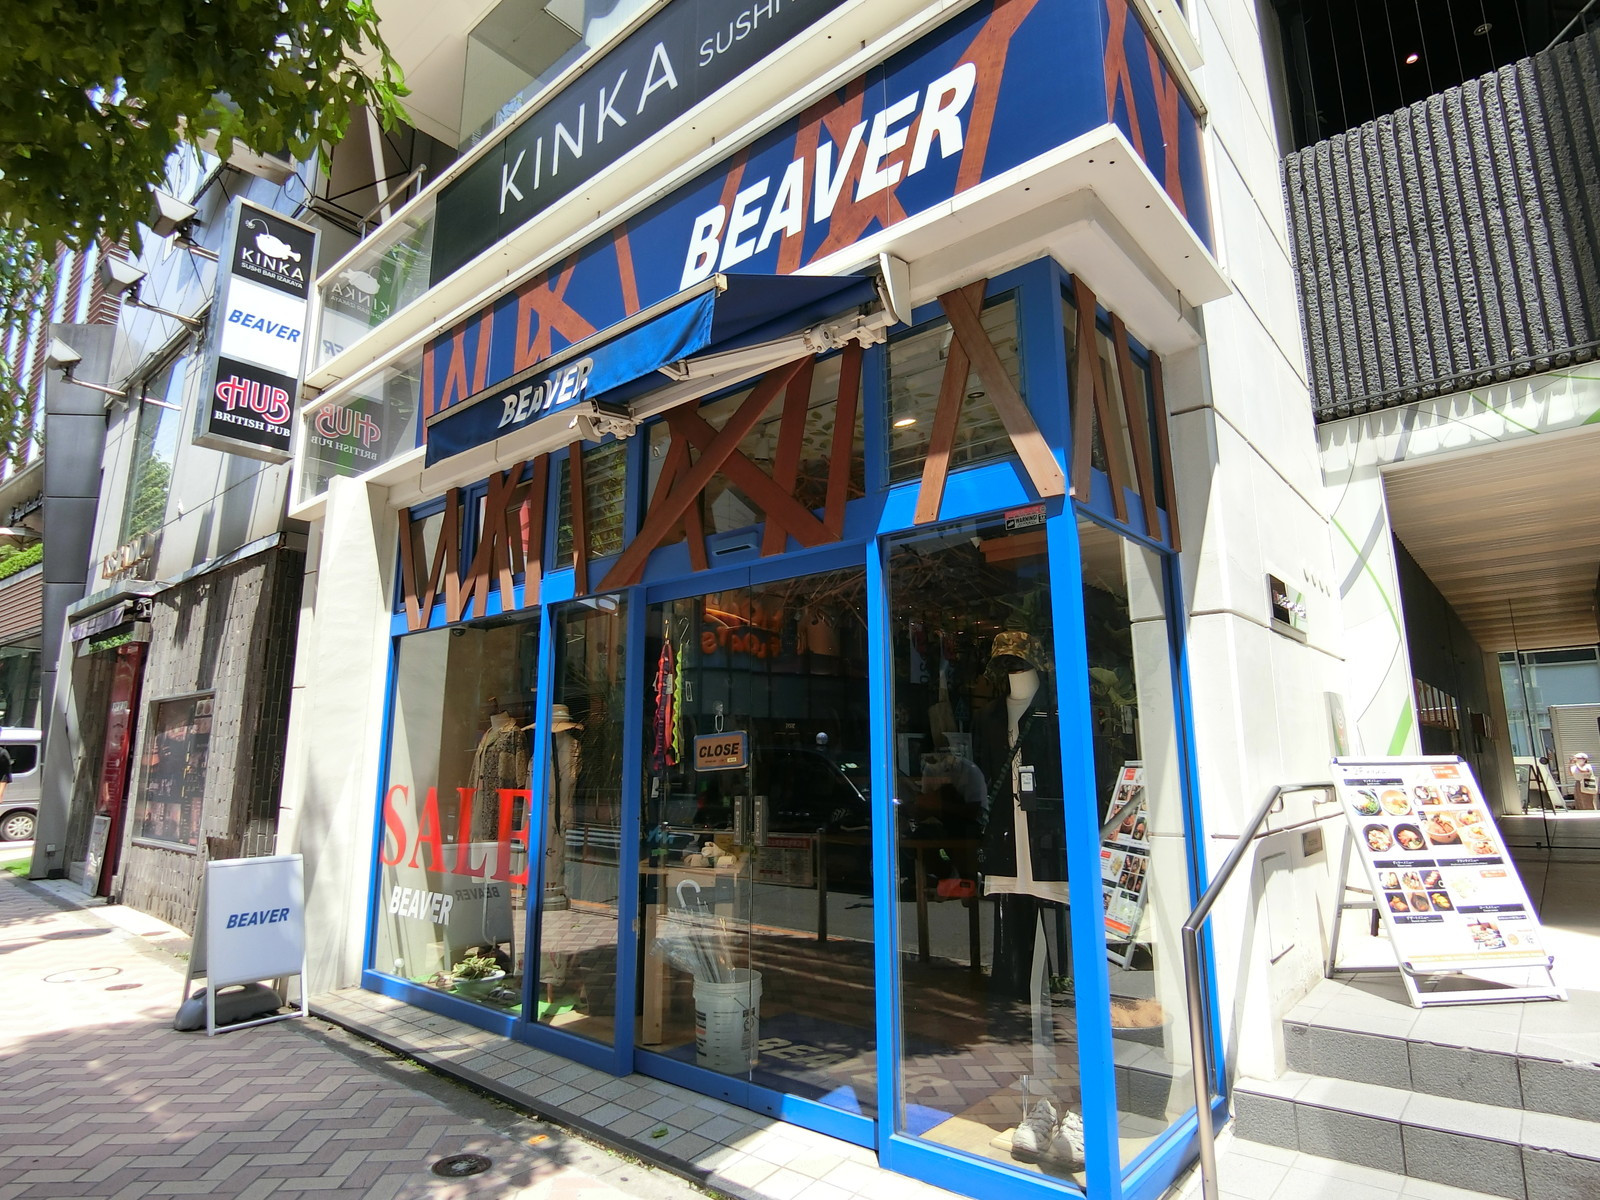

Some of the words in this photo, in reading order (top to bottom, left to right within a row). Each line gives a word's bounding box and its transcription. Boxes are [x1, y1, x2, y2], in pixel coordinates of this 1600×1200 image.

[498, 41, 680, 215] KINKA
[679, 62, 977, 291] BEAVER
[241, 262, 262, 274] SUSHI
[262, 270, 276, 280] BAR
[276, 275, 303, 289] IZAKAYA
[242, 247, 304, 282] KINKA
[228, 309, 301, 343] BEAVER
[215, 374, 291, 425] HUB
[497, 357, 594, 429] BEAVER
[214, 410, 265, 431] BRITISH
[267, 423, 291, 437] PUB
[699, 742, 740, 758] CLOSE
[380, 784, 534, 885] SALE
[226, 907, 290, 929] BEAVER
[388, 885, 455, 926] BEAVER
